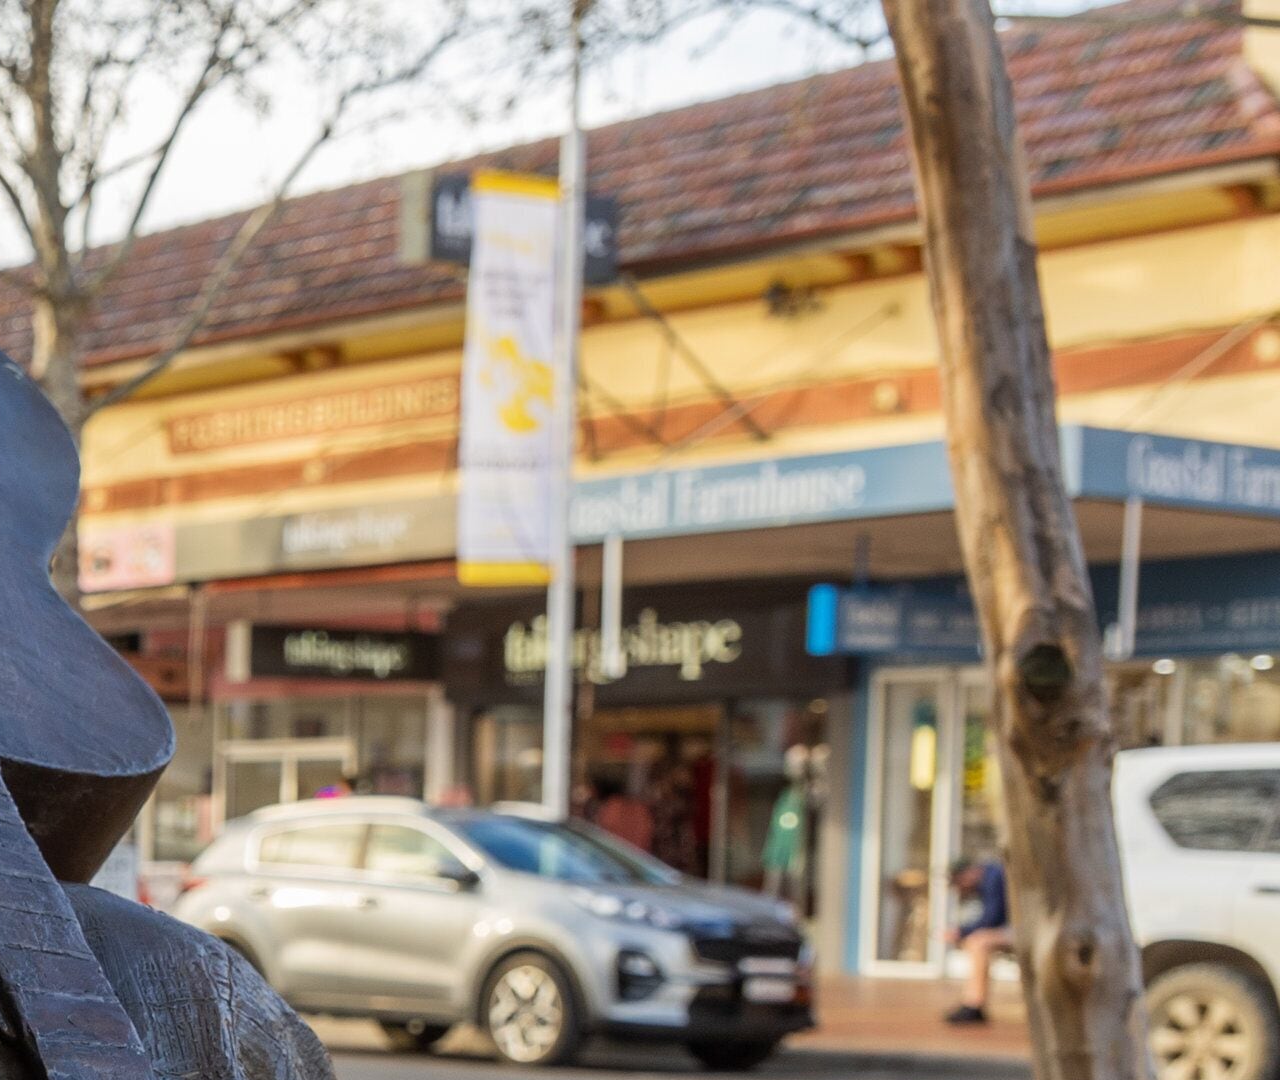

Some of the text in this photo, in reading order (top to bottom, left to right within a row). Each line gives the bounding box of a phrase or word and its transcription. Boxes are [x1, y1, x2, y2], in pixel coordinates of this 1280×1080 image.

[570, 459, 866, 536] oastal Farmhouse
[505, 608, 744, 684] takng shape
